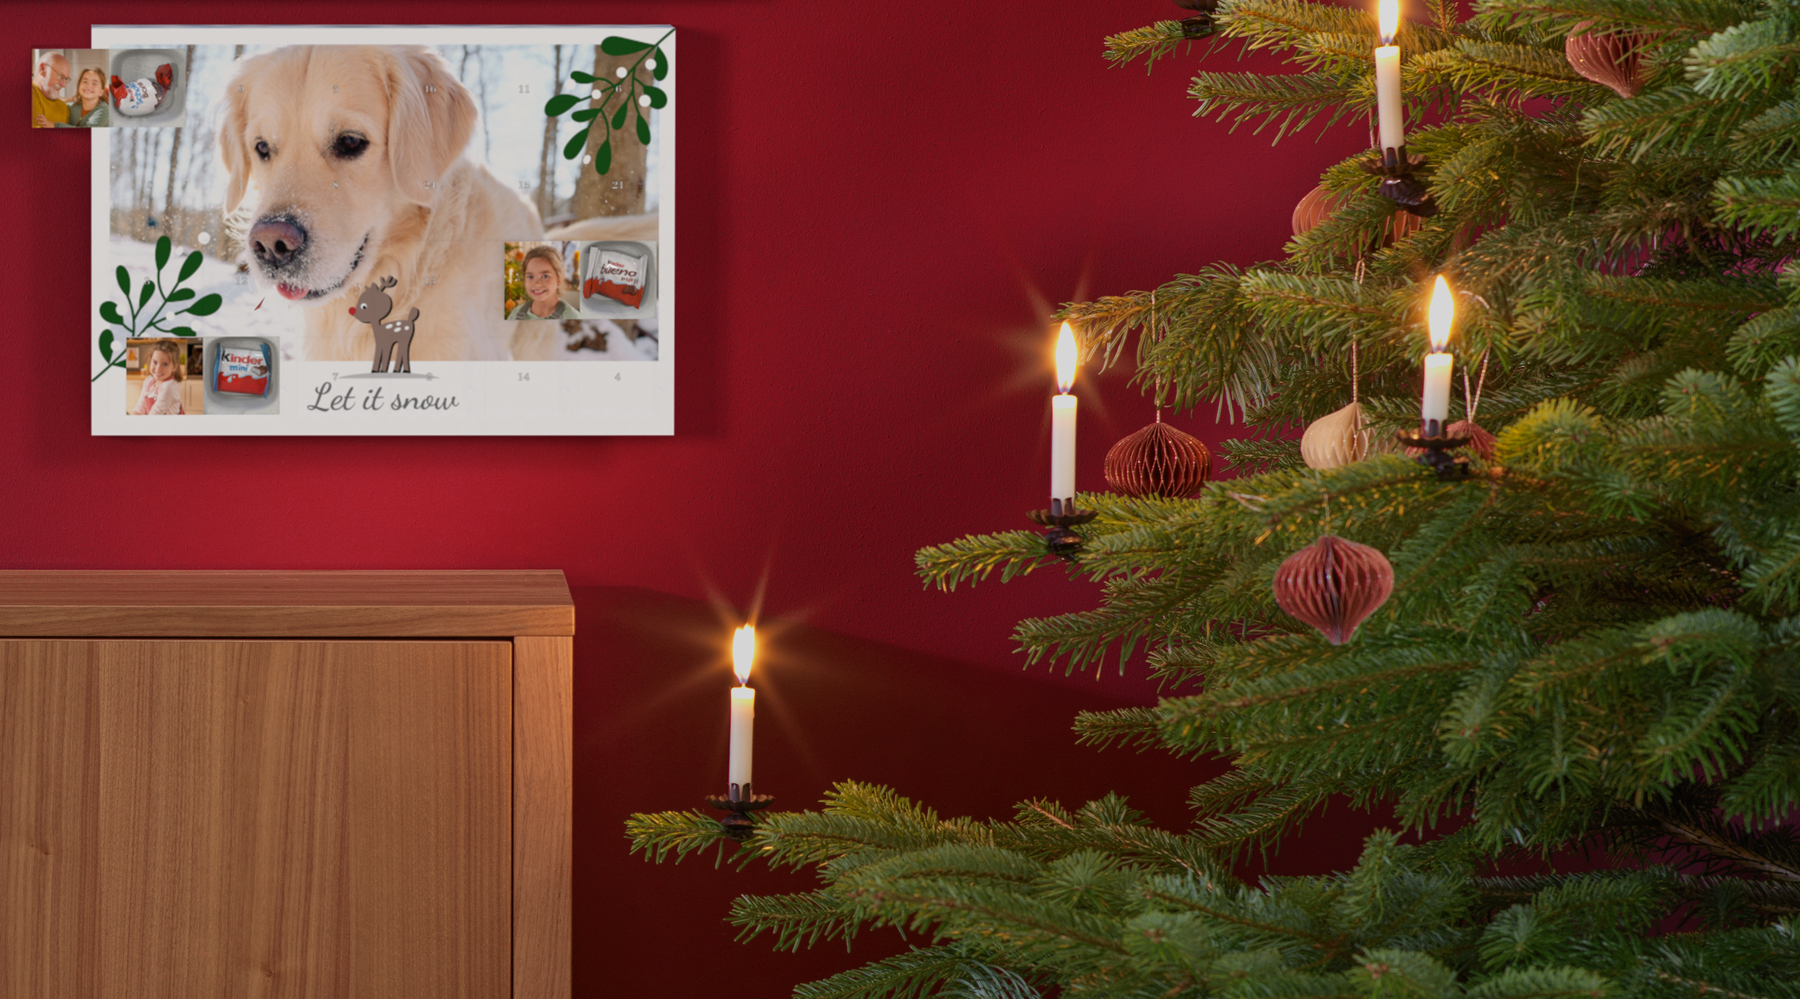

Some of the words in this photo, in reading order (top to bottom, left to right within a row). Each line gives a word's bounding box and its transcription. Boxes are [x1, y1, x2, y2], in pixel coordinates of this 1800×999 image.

[424, 84, 437, 93] 16
[615, 84, 622, 93] 6
[423, 181, 436, 189] 24
[612, 181, 623, 189] 21
[600, 263, 637, 277] bueno
[235, 276, 248, 285] 12
[221, 350, 263, 365] kinder
[229, 364, 249, 372] mini
[332, 372, 339, 381] 7
[307, 381, 356, 412] Let
[362, 386, 385, 411] it
[391, 393, 459, 411] snow
